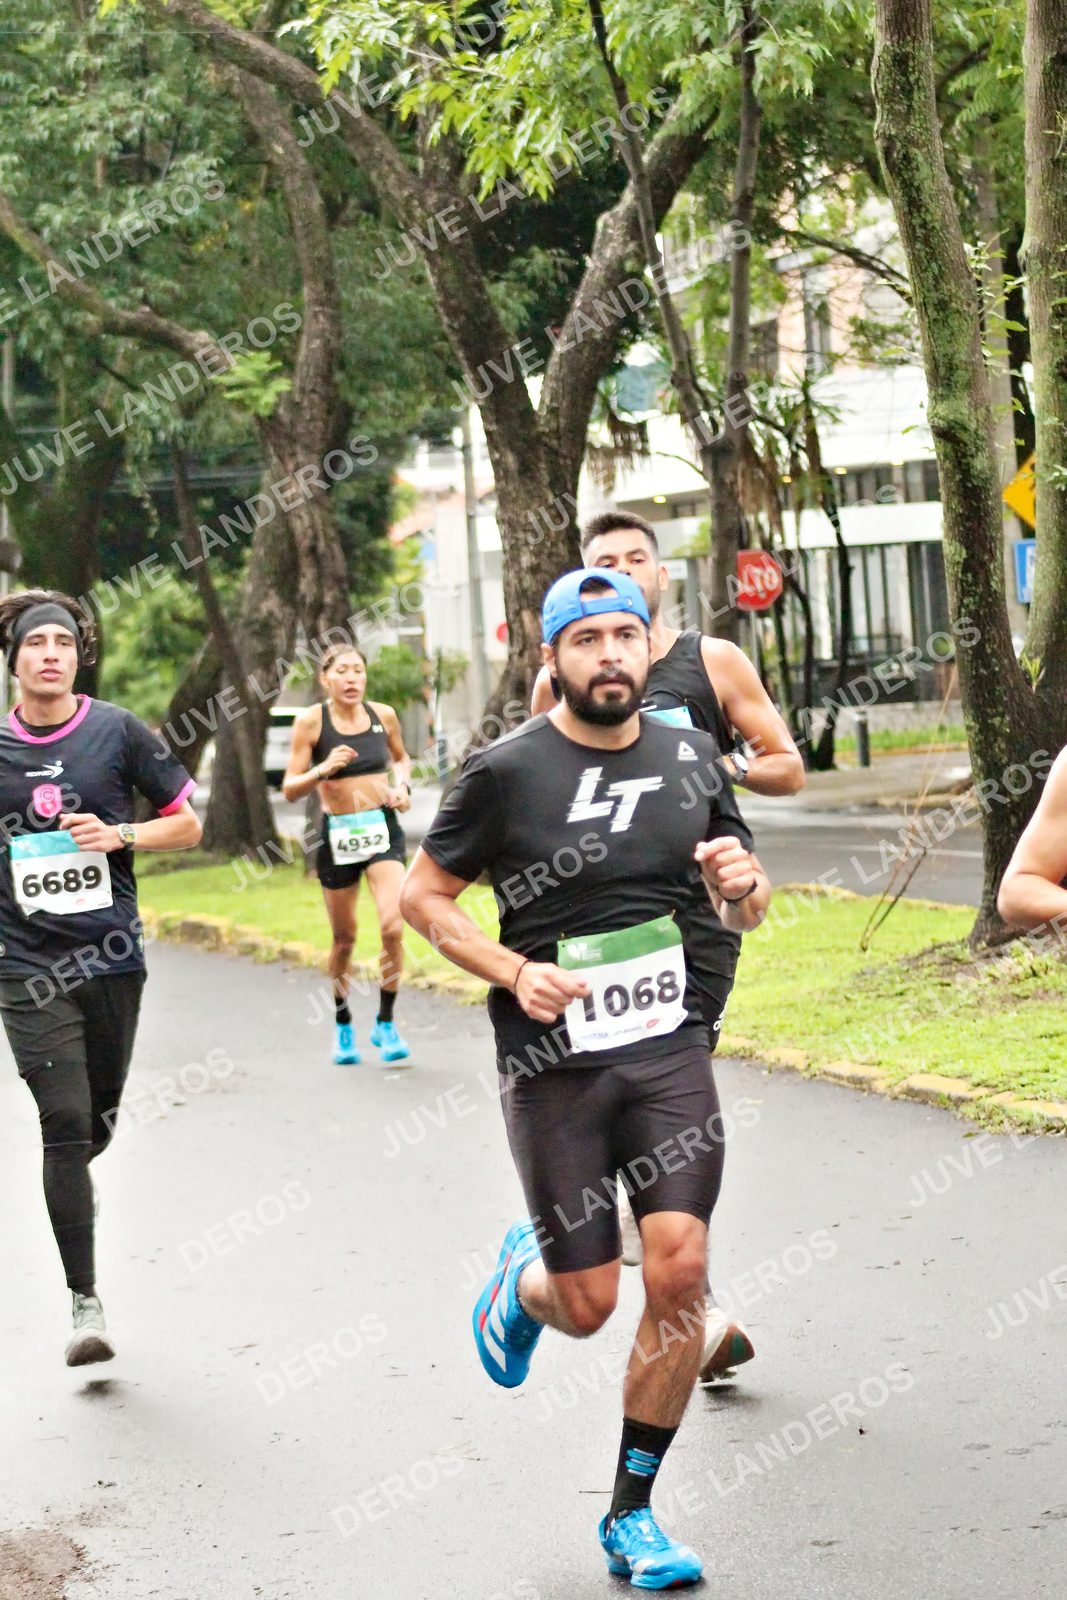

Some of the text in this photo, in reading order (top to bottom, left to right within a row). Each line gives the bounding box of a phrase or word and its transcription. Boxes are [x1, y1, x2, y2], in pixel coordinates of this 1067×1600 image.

[567, 766, 666, 833] LT
[337, 834, 384, 852] 4932
[22, 865, 103, 898] 6689
[582, 970, 680, 1022] 1068
